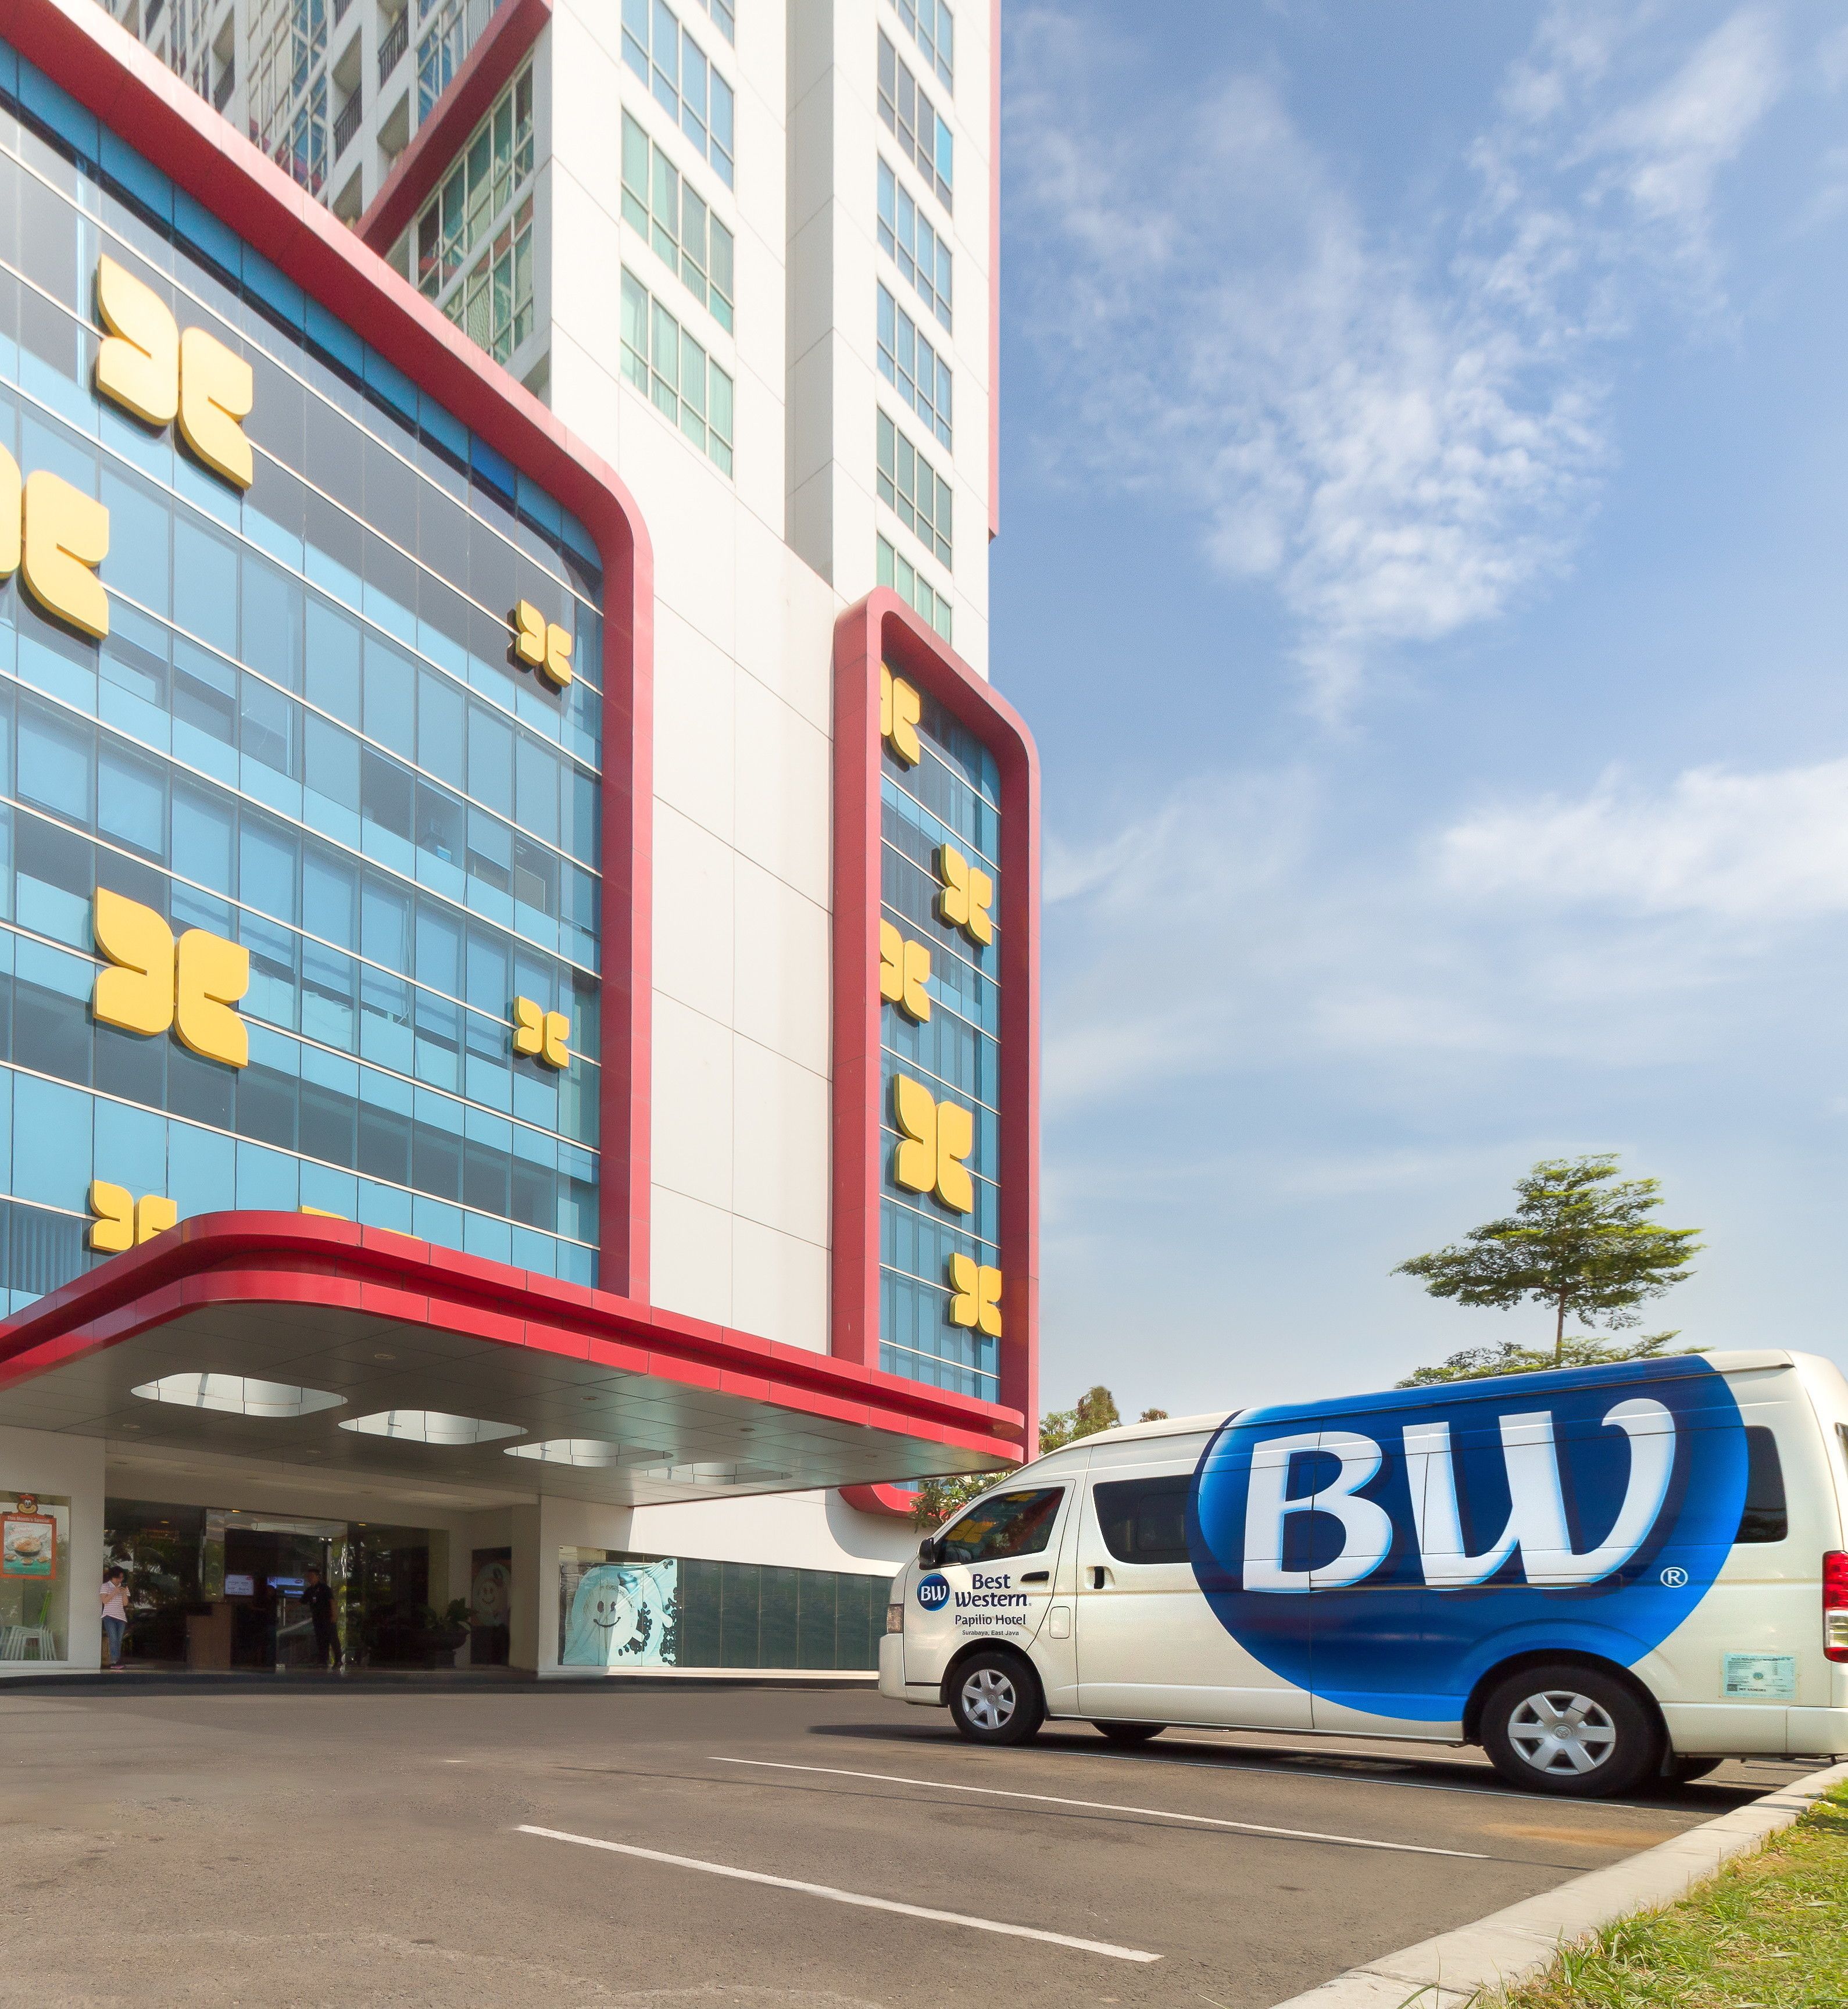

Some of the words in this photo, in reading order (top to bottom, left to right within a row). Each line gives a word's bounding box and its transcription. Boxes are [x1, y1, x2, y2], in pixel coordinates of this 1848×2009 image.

[1243, 1397, 1677, 1593] BW
[972, 1573, 1011, 1590] Best
[920, 1585, 946, 1602] BW
[955, 1591, 1028, 1607] Western
[955, 1614, 992, 1628] Papilio
[995, 1614, 1026, 1625] Hotel
